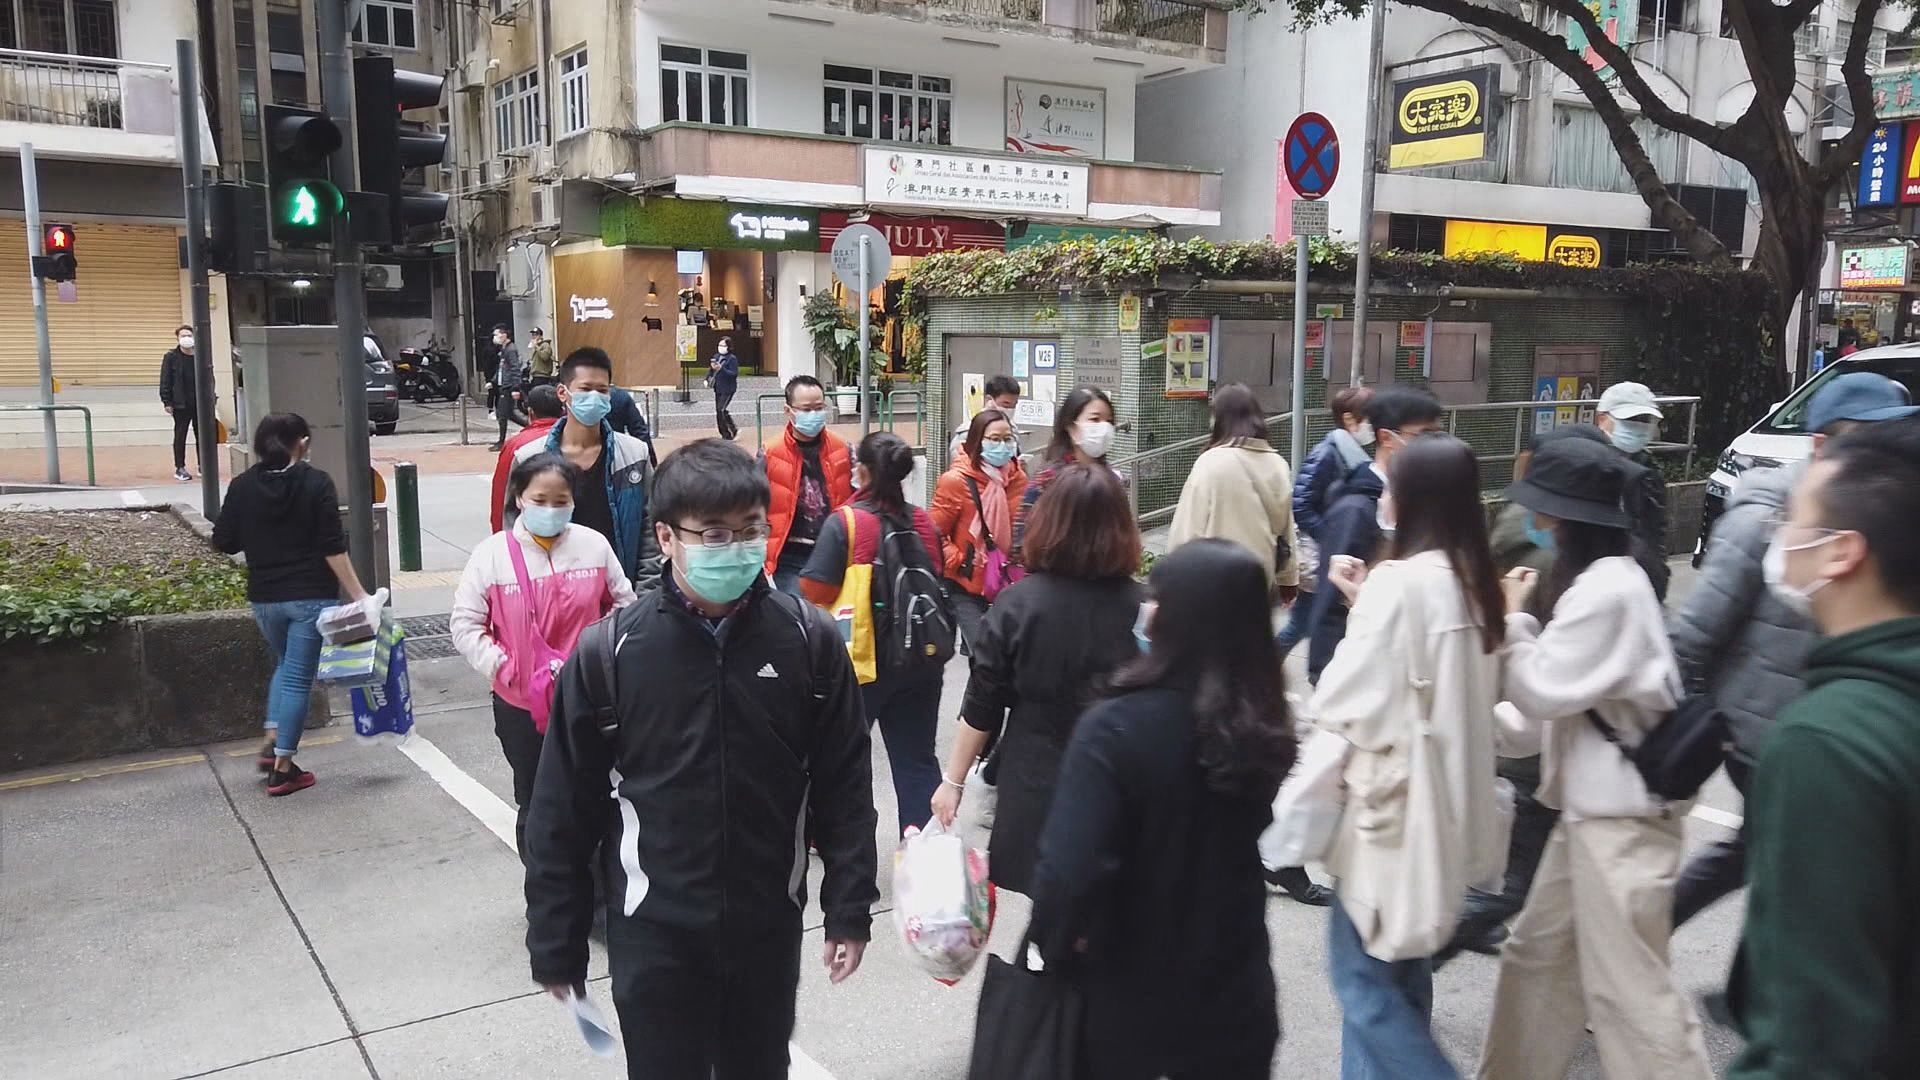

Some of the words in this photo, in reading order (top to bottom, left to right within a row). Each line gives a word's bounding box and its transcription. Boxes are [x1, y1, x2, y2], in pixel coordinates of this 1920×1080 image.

[1409, 94, 1466, 126] 大家樂
[884, 225, 950, 249] JULY
